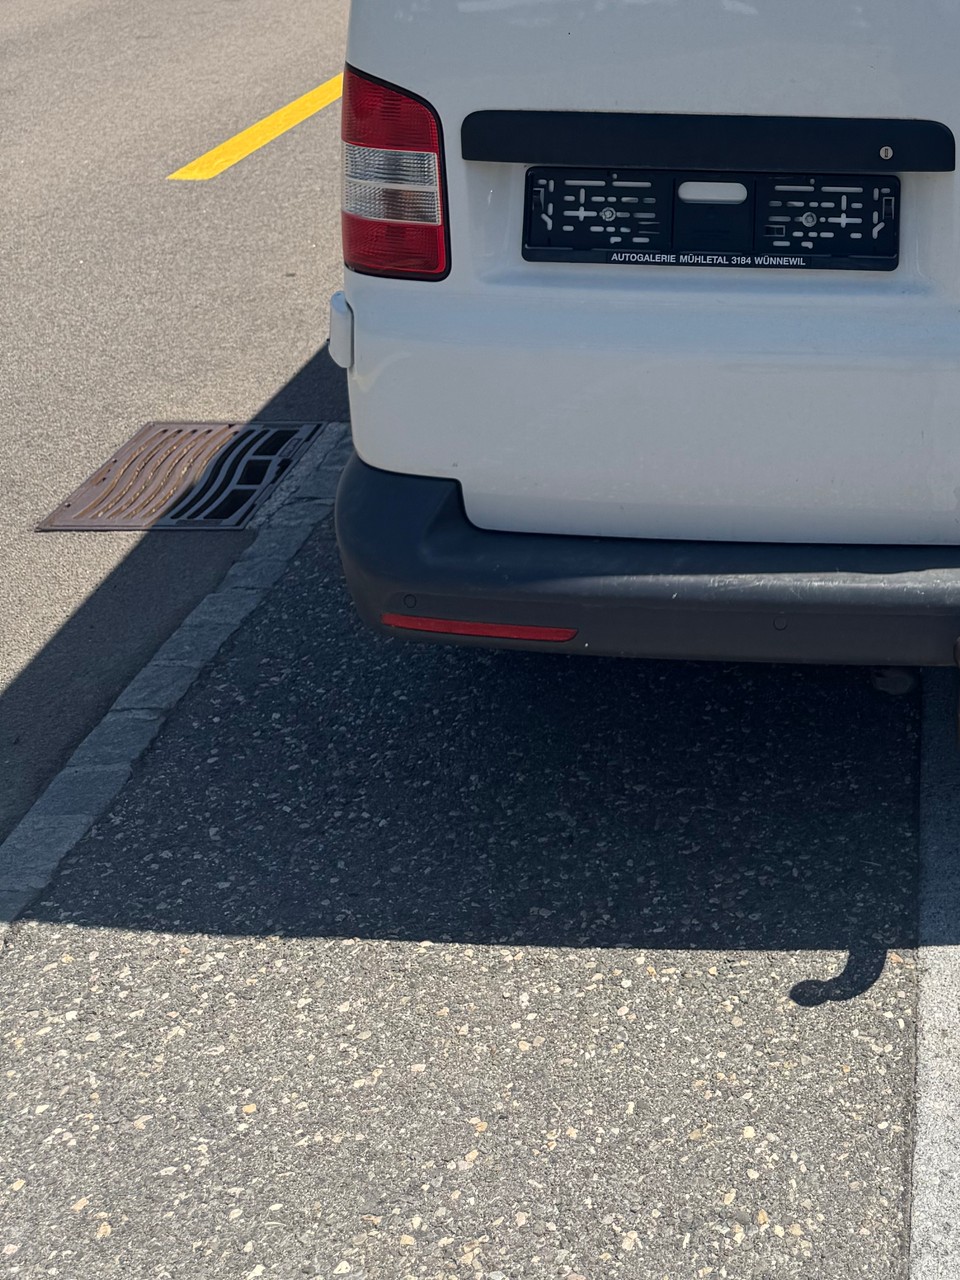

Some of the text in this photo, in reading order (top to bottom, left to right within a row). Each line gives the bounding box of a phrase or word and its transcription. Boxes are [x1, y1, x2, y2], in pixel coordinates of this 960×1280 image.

[611, 253, 806, 266] AUTOGALERIE MÜHLETAL 3184 WÜNNEWIL
